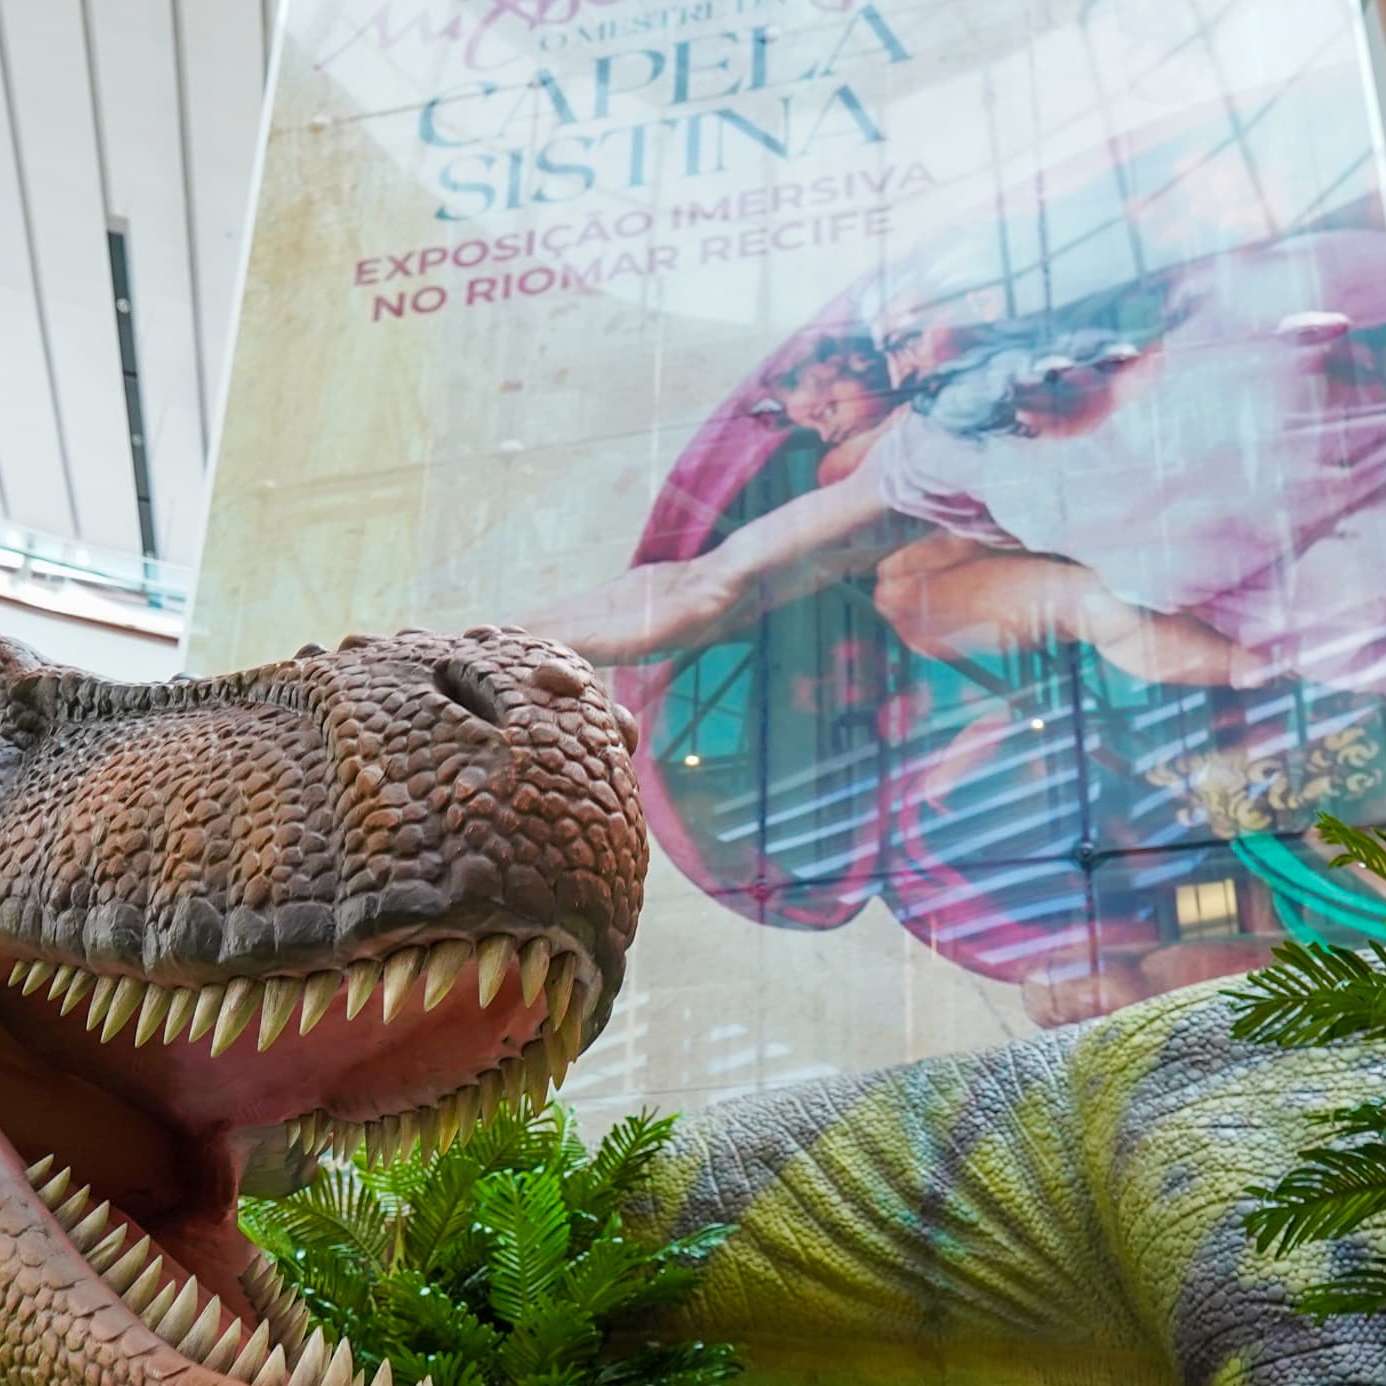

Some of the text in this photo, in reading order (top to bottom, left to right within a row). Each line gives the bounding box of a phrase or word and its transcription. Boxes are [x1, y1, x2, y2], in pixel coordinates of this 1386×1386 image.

[419, 3, 912, 147] CAPELA
[433, 84, 887, 222] SISTINA
[353, 161, 935, 287] EXPOSIÇÃO IMERSIVA
[372, 205, 895, 323] NO RIOMAR RECIFE
